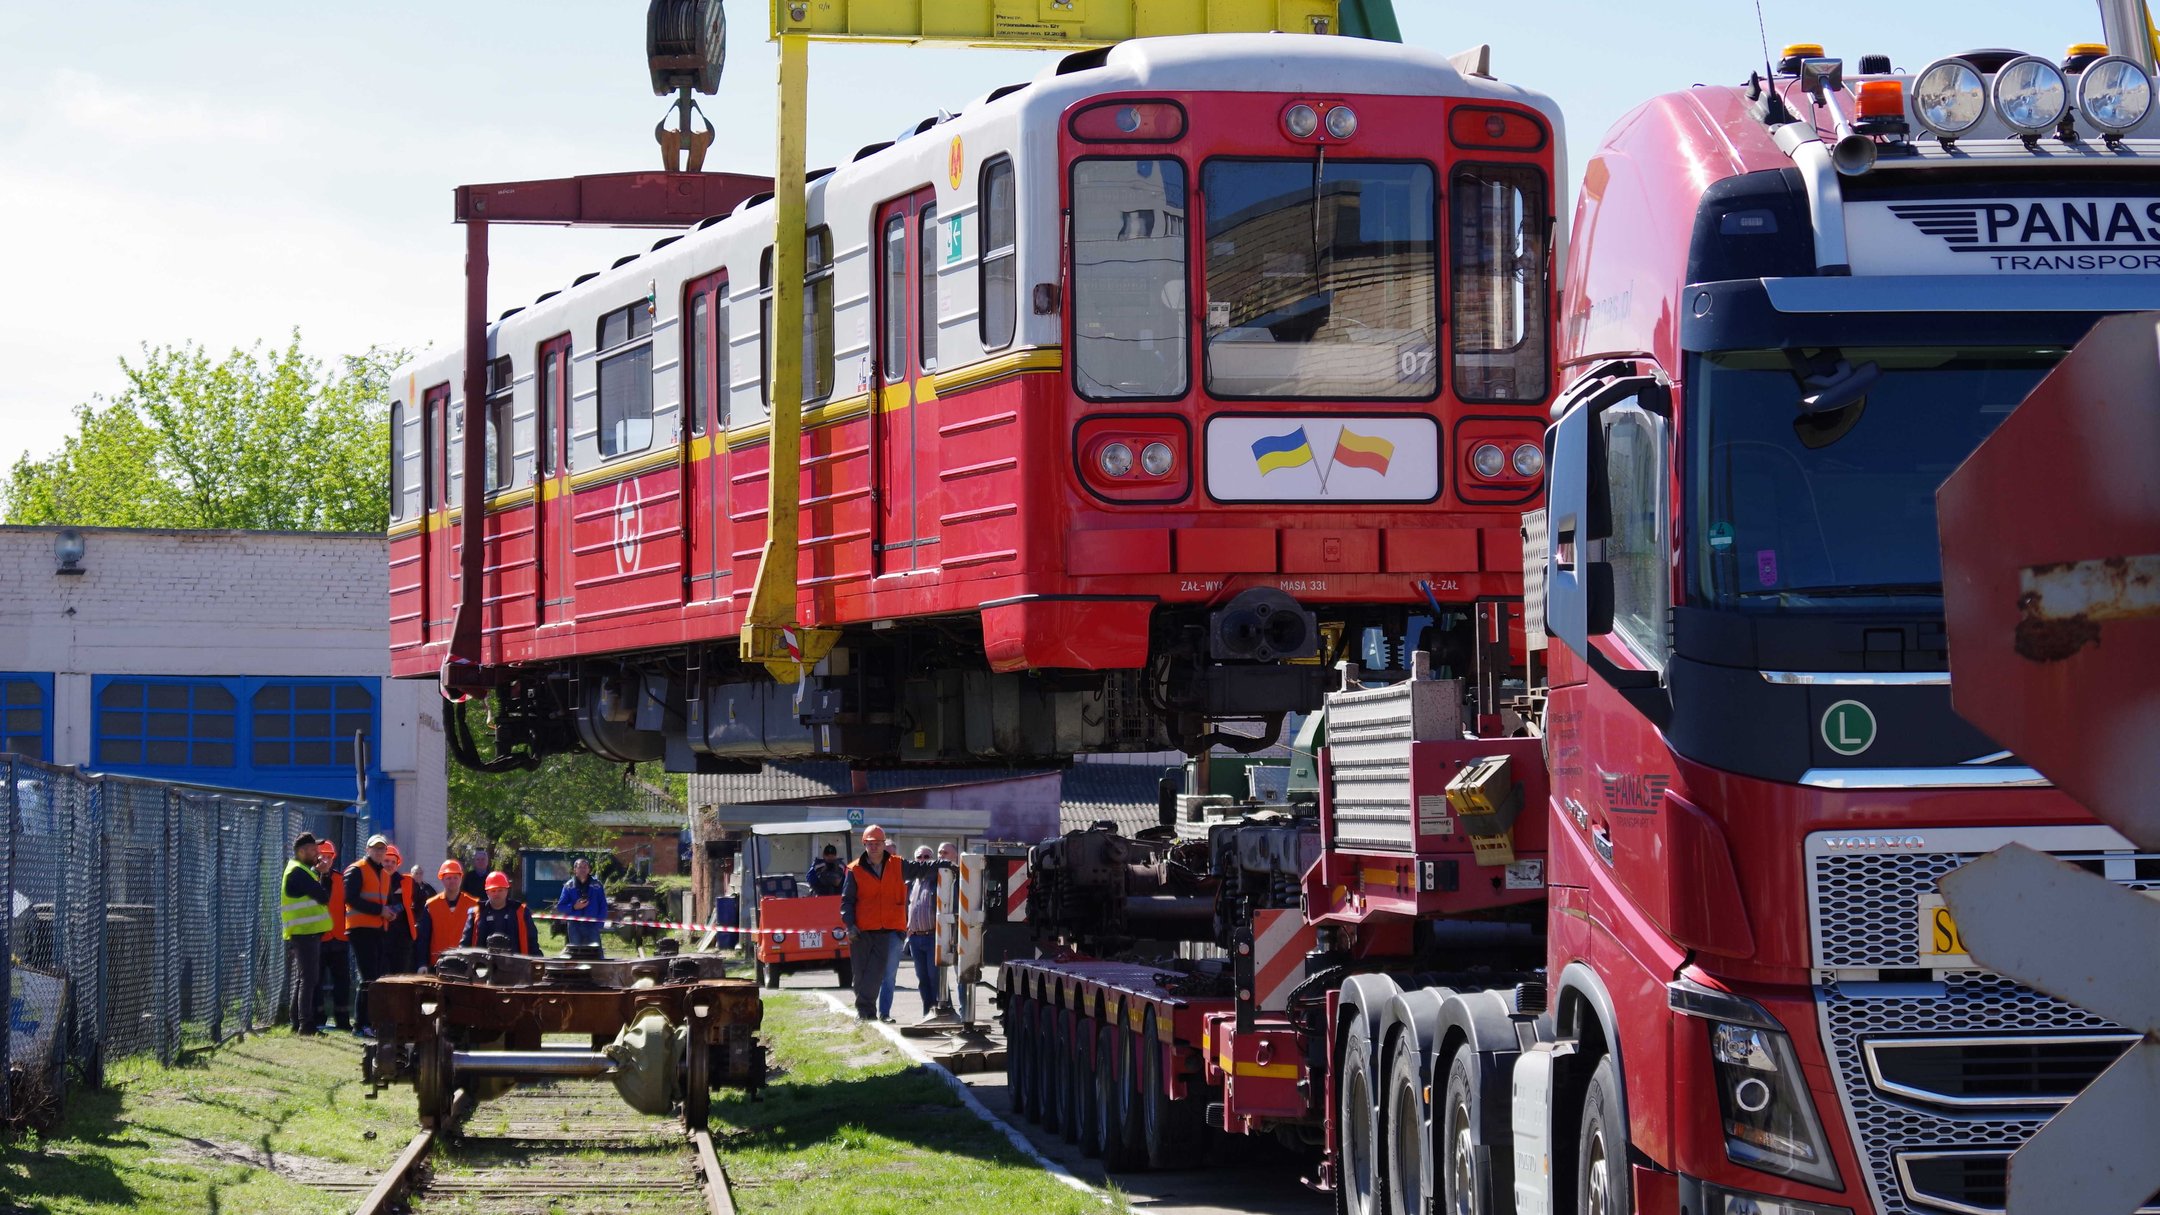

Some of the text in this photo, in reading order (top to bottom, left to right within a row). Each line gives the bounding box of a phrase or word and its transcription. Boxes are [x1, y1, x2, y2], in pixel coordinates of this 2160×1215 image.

[1990, 255, 2160, 270] TRANSPOR
[1401, 351, 1432, 375] 07
[1716, 522, 1725, 535] 4
[1280, 581, 1306, 591] MASA
[1839, 711, 1861, 744] L
[1615, 774, 1650, 807] PANAS
[1823, 835, 1925, 851] VOLVO
